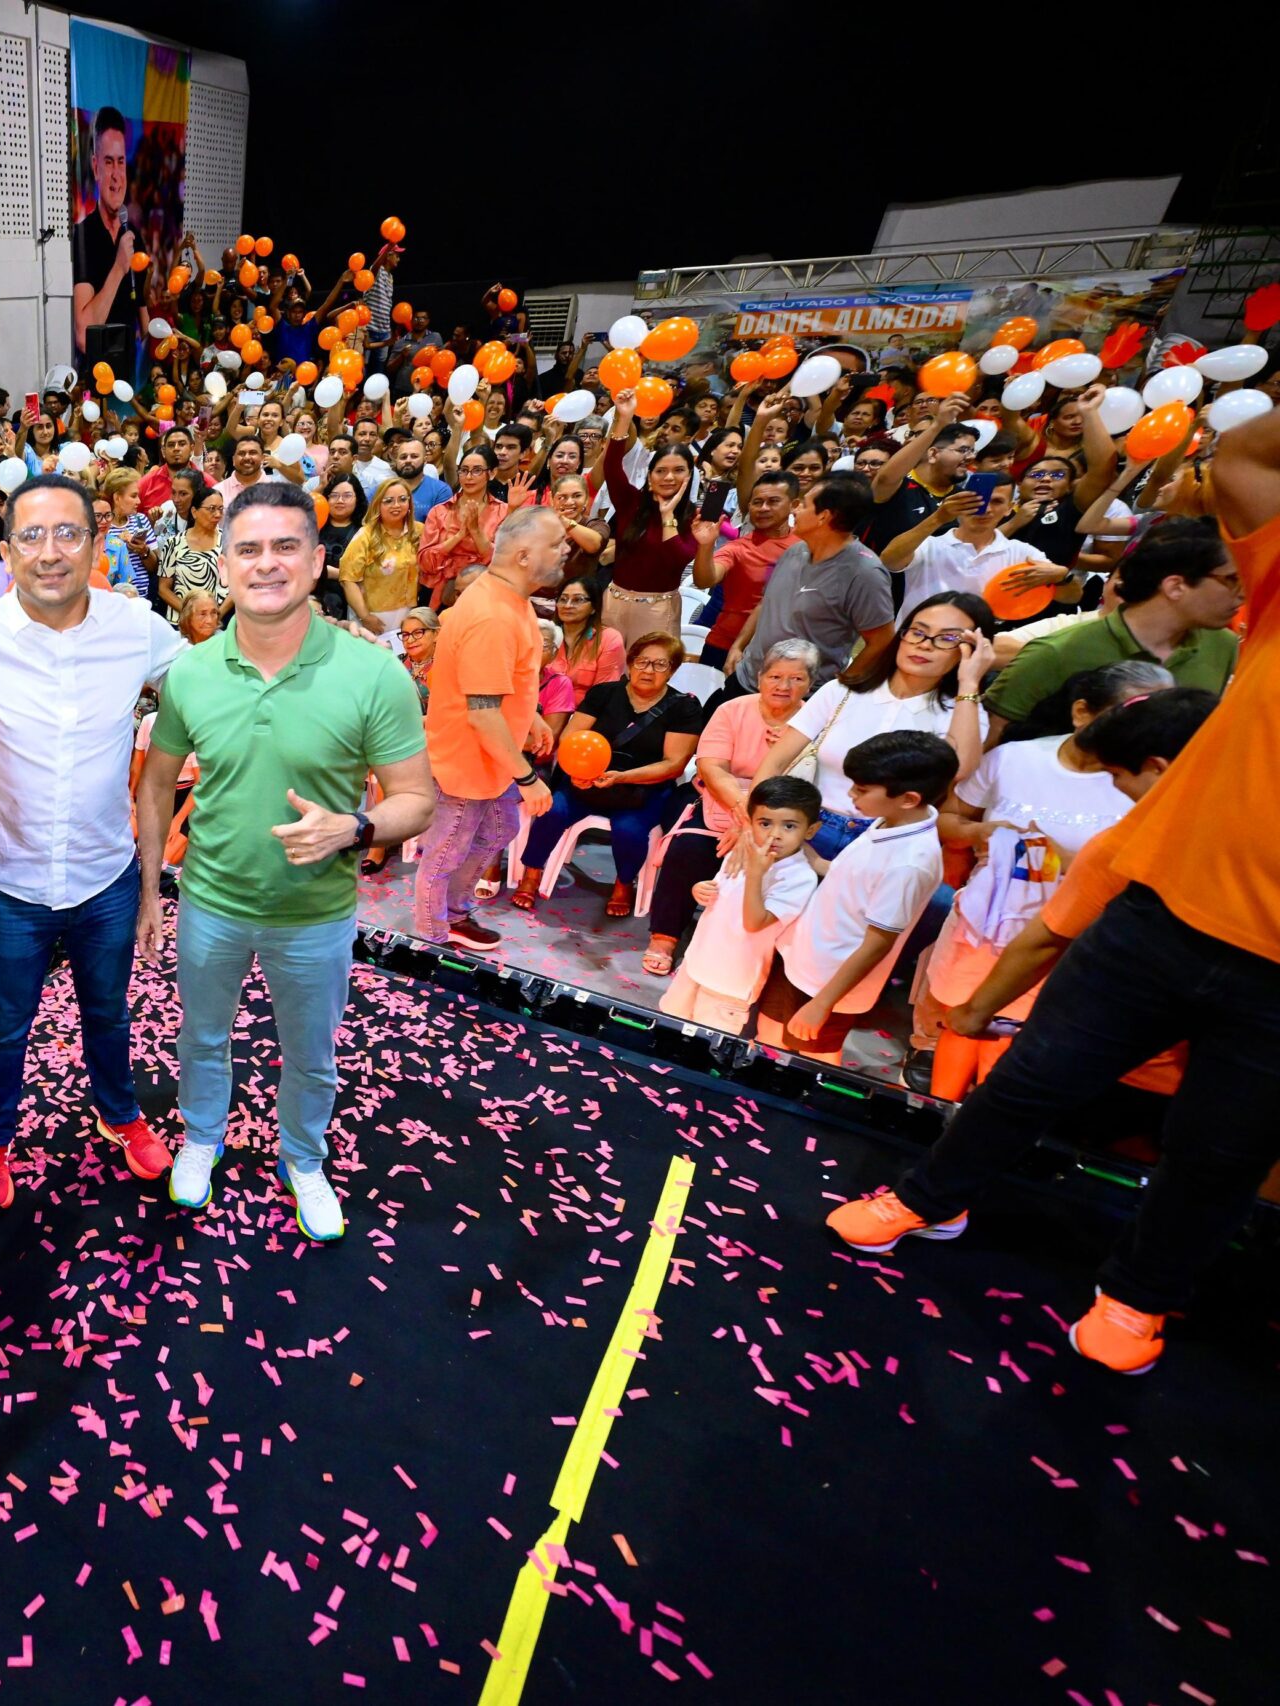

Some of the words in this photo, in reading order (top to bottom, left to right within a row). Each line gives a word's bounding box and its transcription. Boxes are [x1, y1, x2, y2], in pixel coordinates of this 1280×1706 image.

[745, 298, 847, 310] DEPUTADO
[854, 293, 963, 304] ESTADUAL
[738, 311, 824, 335] DANIEL
[834, 306, 958, 331] ALMEIDA
